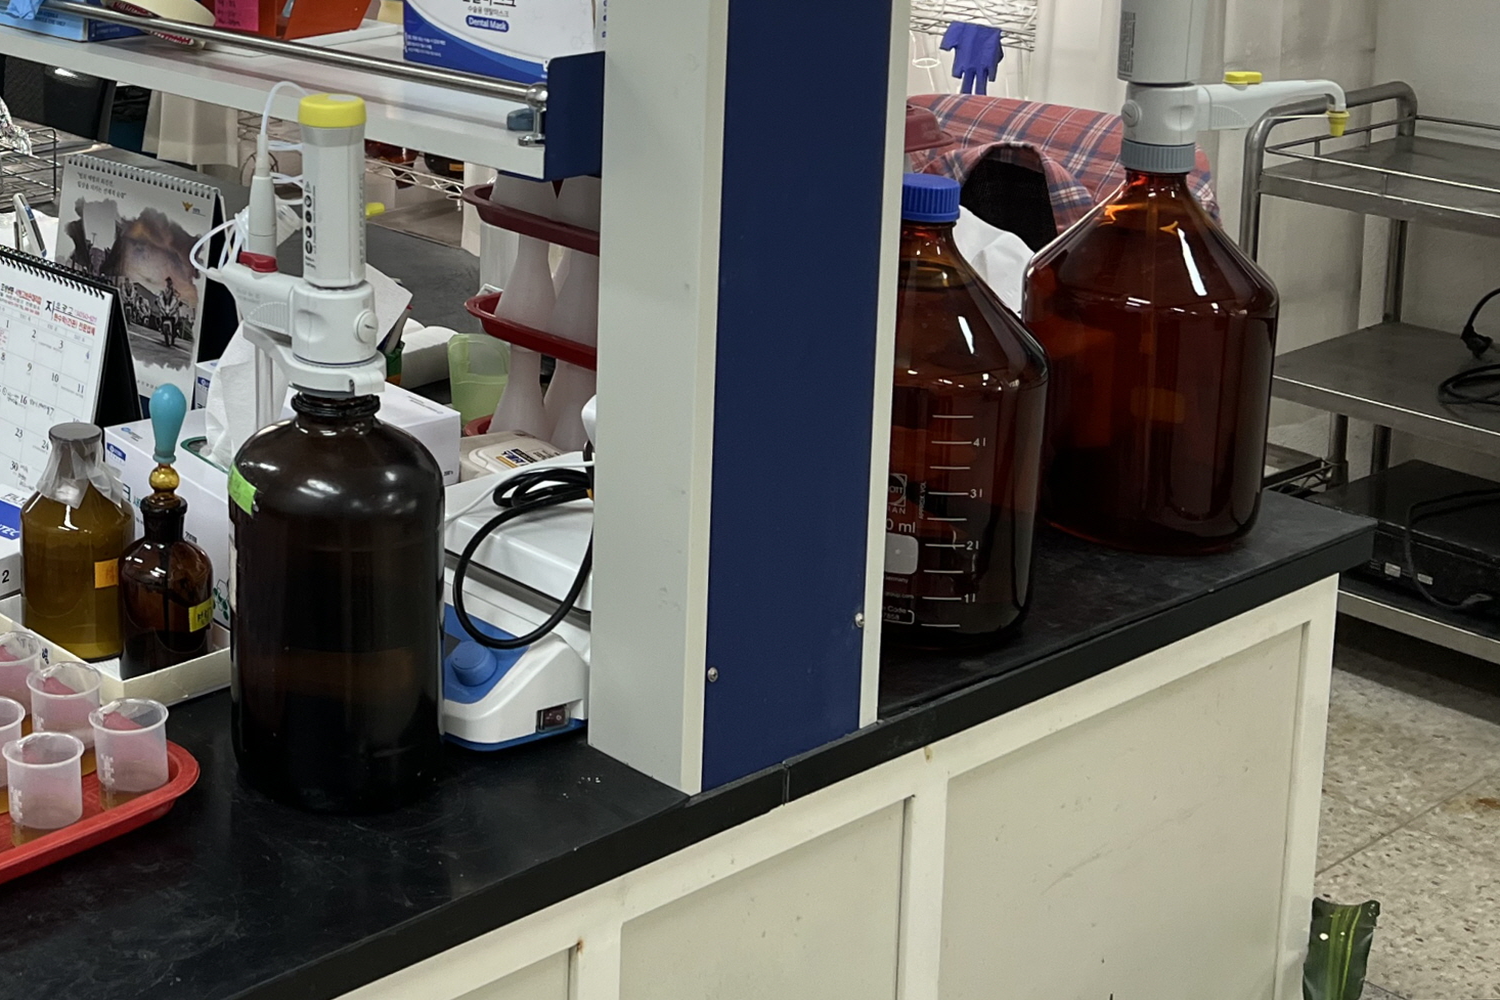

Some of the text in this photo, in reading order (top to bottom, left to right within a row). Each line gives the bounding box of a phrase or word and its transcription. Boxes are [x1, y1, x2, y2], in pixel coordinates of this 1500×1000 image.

[468, 16, 508, 31] Dental Mask
[5, 320, 10, 329] 1
[31, 329, 37, 339] 2
[59, 340, 64, 349] 3
[1, 352, 6, 361] 8
[27, 362, 32, 372] 9
[51, 372, 60, 383] 10
[77, 383, 85, 394] 11
[19, 394, 28, 405] 16
[46, 406, 55, 416] 17
[15, 428, 24, 438] 23
[41, 440, 49, 450] 24
[10, 461, 19, 471] 30
[889, 485, 903, 494] OTT
[898, 521, 916, 534] ml
[2, 569, 10, 584] 2
